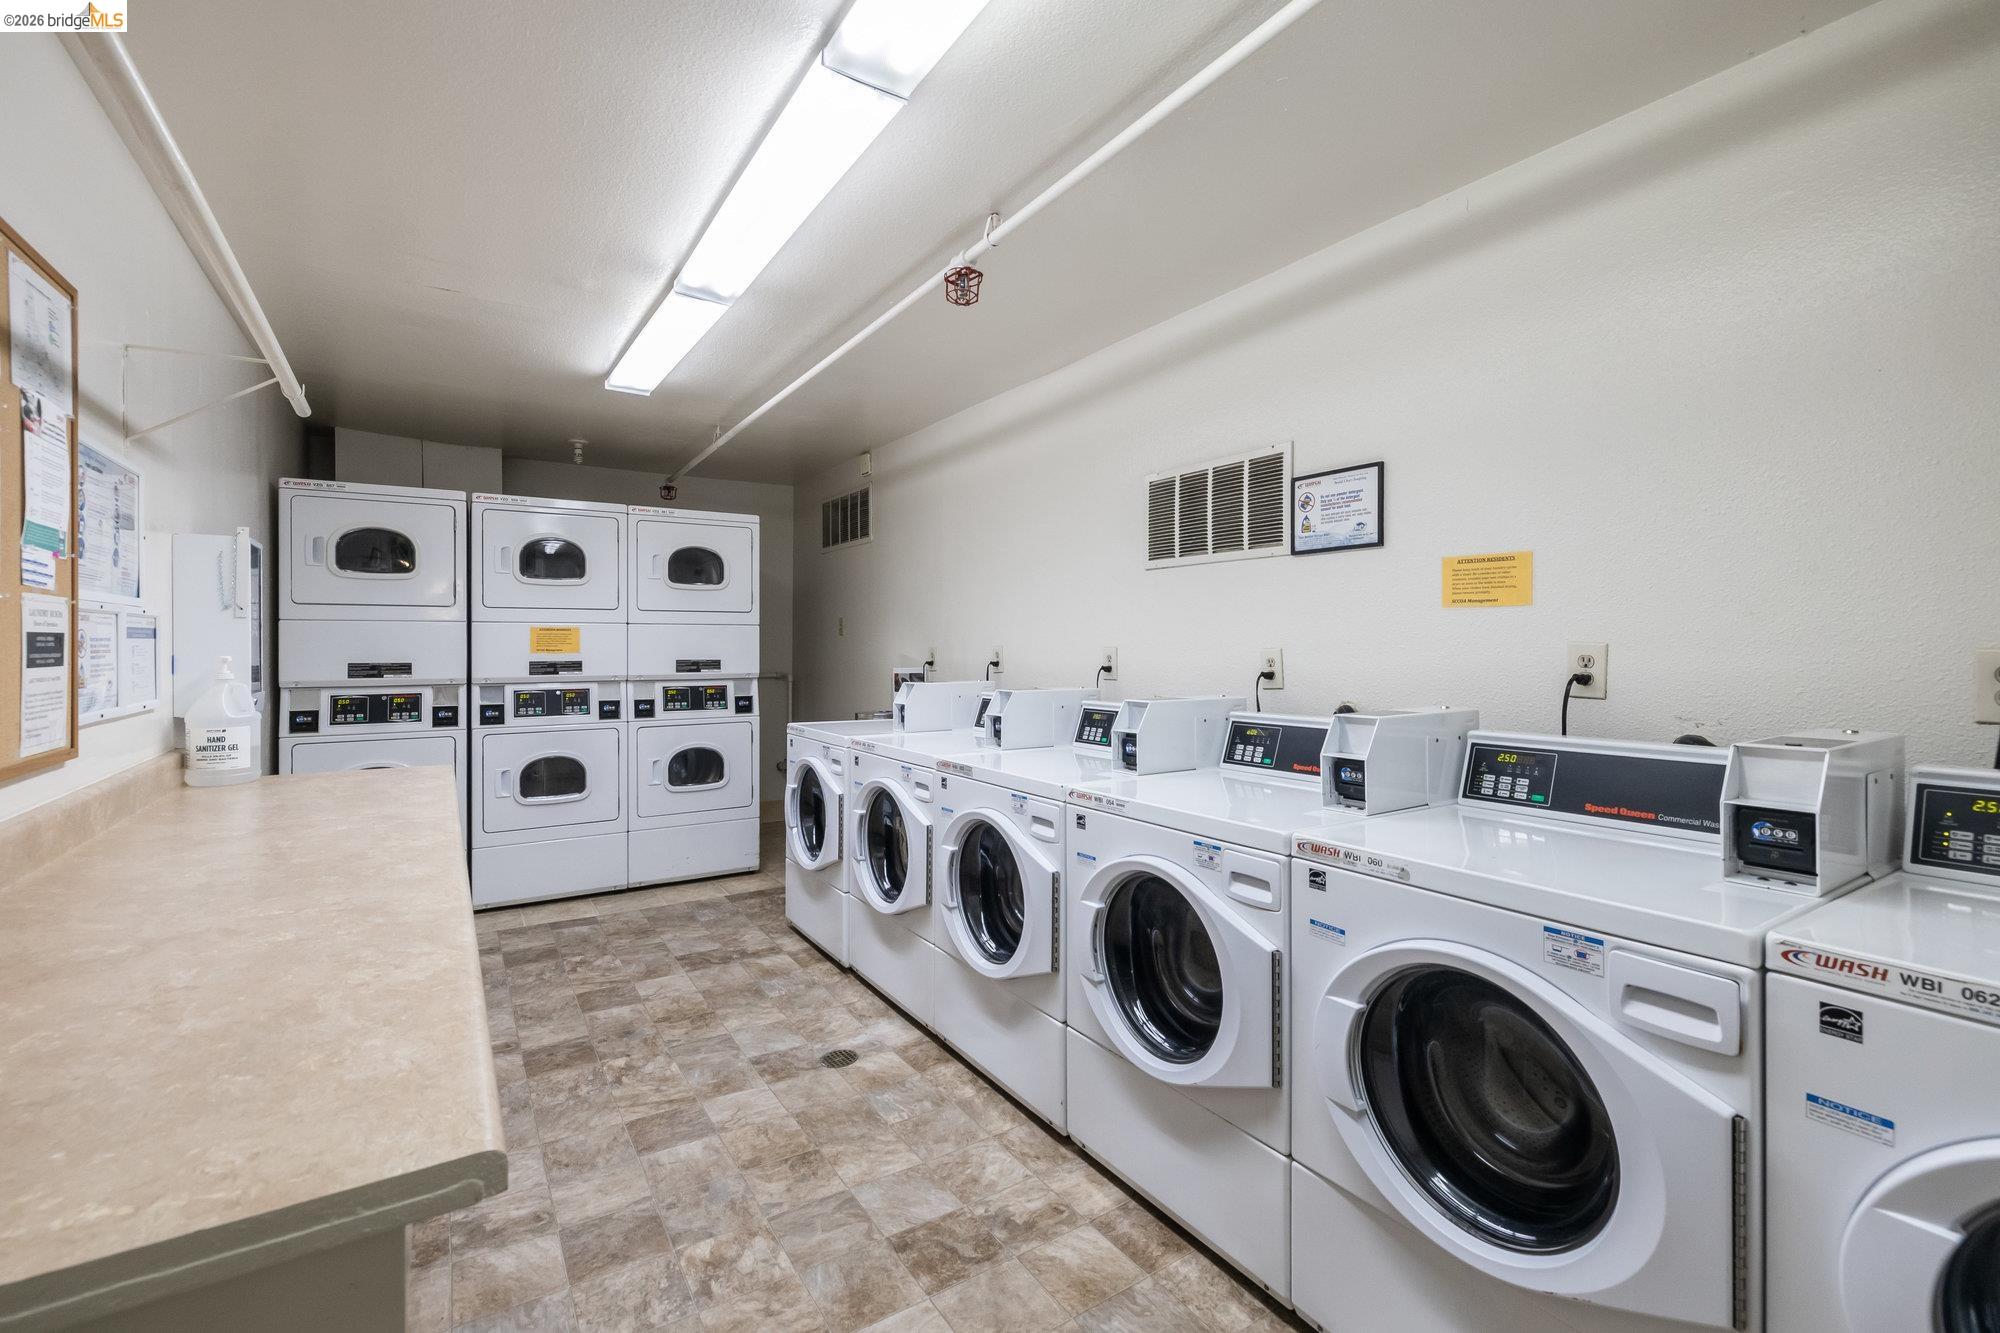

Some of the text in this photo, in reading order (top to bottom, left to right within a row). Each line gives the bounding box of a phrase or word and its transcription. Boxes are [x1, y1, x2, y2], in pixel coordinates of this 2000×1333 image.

[1293, 763, 1312, 772] Speed
[1584, 803, 1720, 828] Speed Queen Commercial Was
[1311, 844, 1382, 867] WASH WBI 060
[1315, 921, 1340, 934] NOTICE
[1561, 931, 1584, 940] NOTICE
[1815, 954, 1889, 982] WASH
[1899, 972, 1943, 993] WBI
[1961, 987, 2000, 1007] 062
[1818, 1098, 1881, 1123] NOTICE
